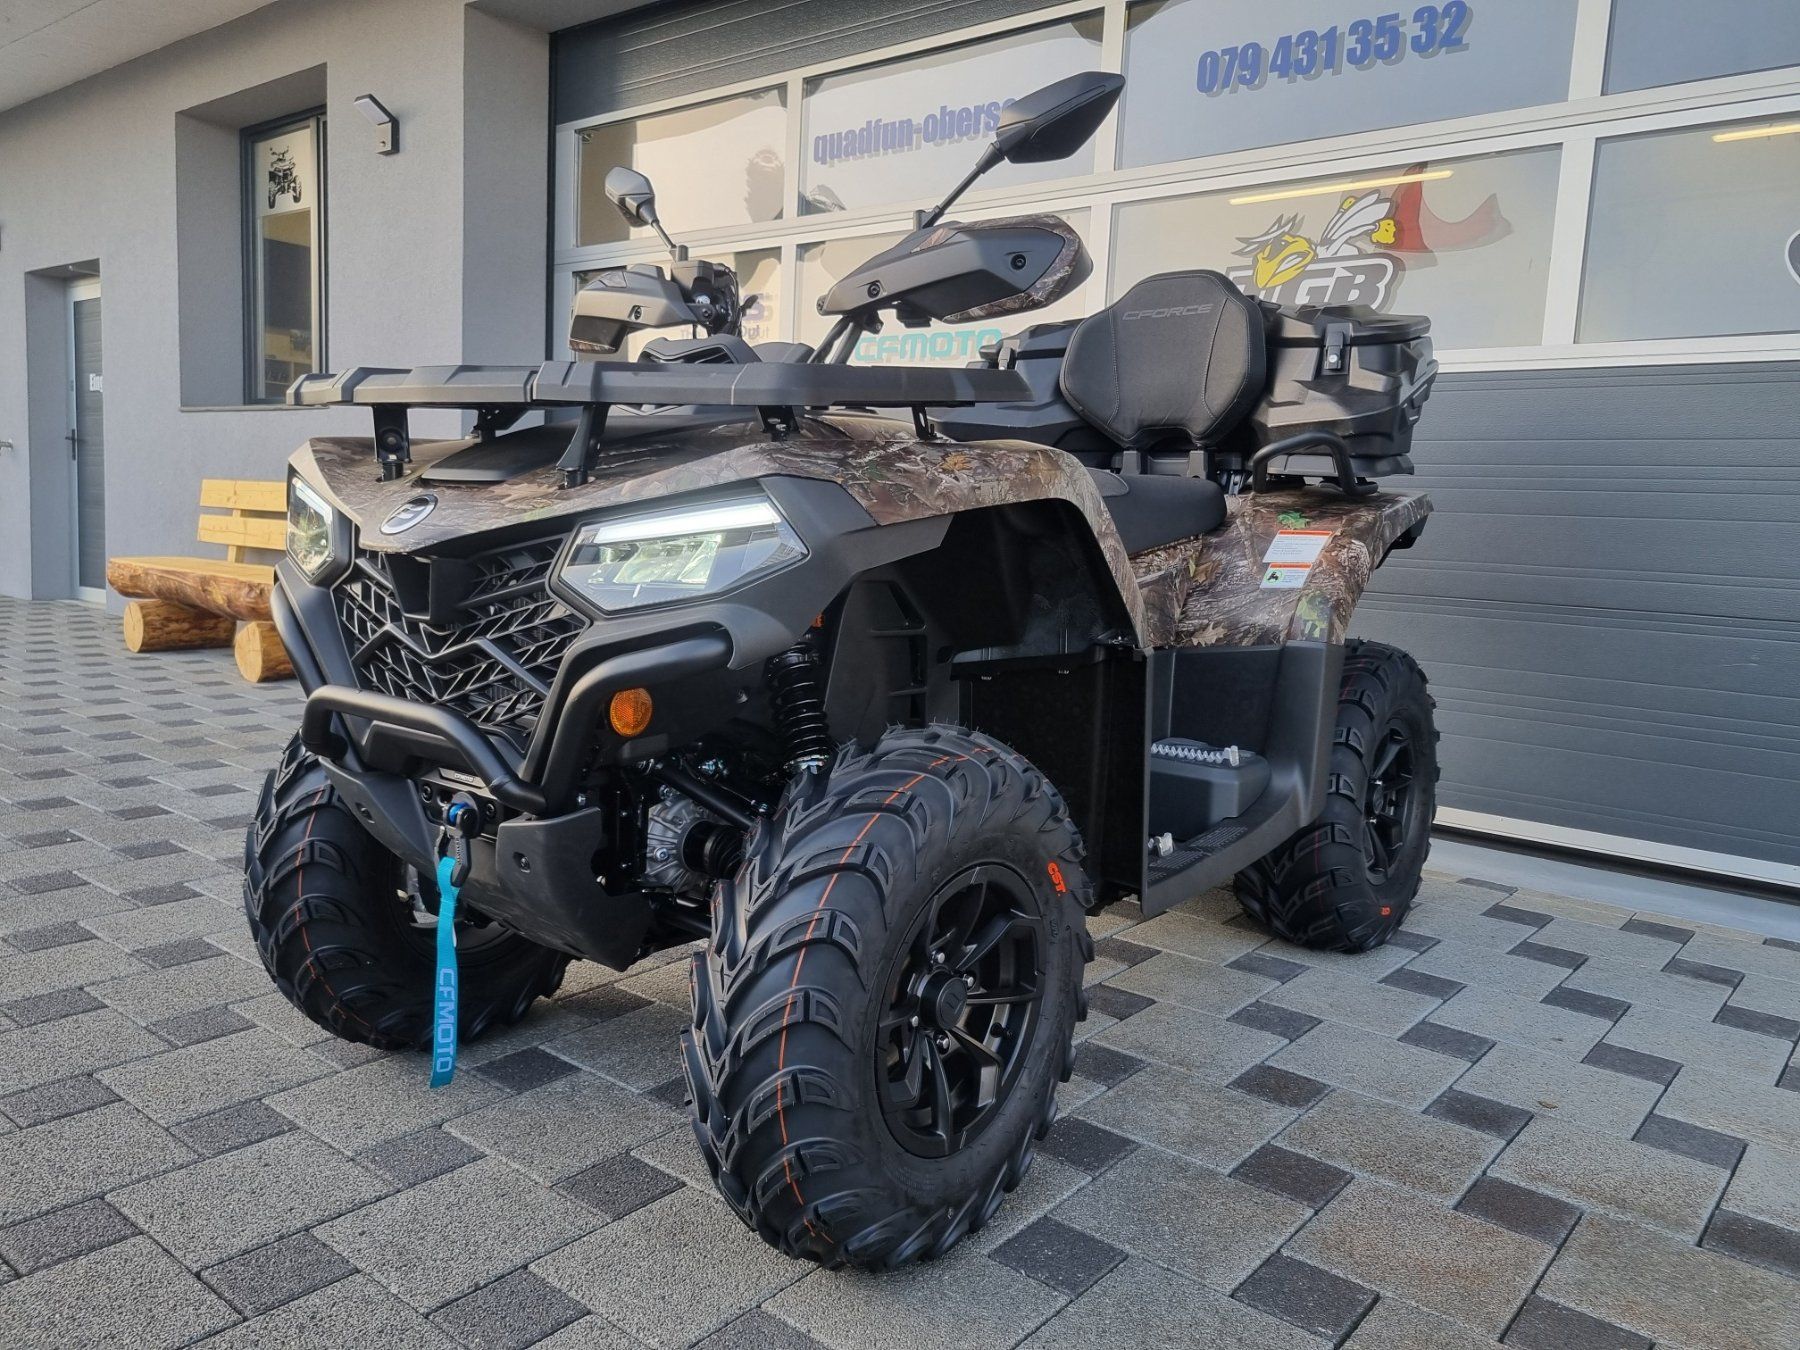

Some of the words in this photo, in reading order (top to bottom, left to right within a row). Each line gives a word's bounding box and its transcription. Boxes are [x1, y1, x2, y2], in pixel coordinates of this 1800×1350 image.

[1196, 42, 1262, 94] 079
[1269, 25, 1338, 79] 431
[1346, 12, 1400, 66] 35
[1411, 0, 1467, 54] 32
[813, 98, 1016, 165] quadfun-obers
[1122, 303, 1214, 321] CFORCE
[436, 968, 455, 1073] CFMOTO
